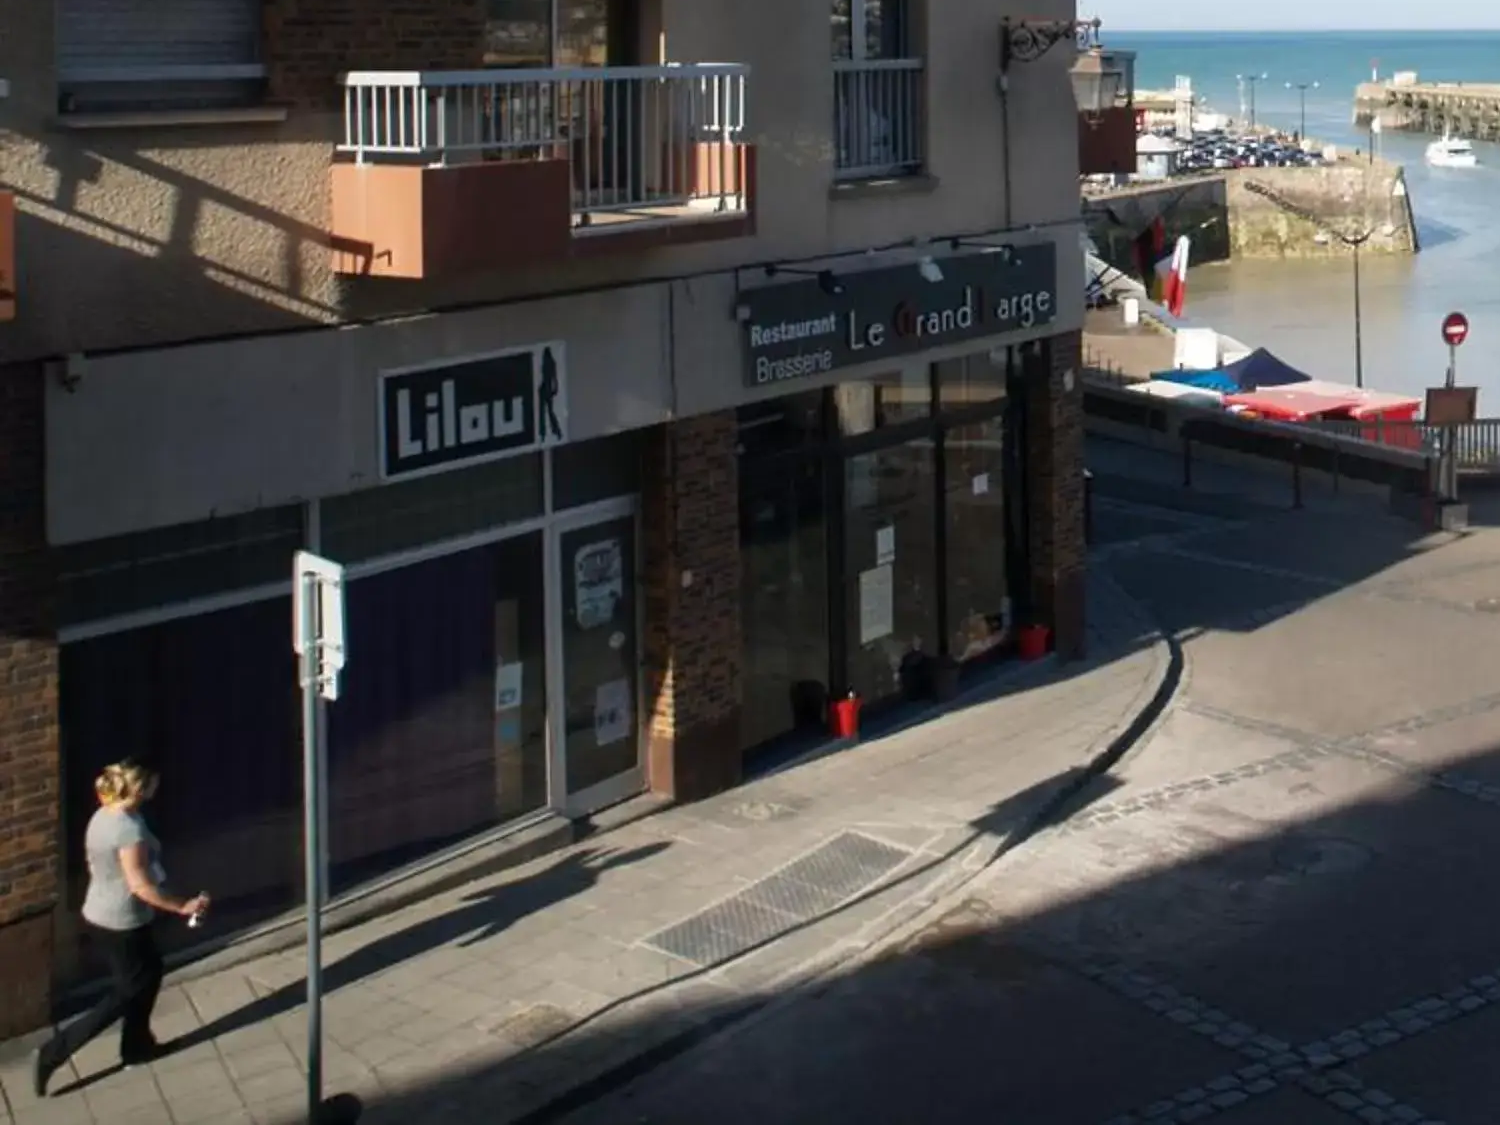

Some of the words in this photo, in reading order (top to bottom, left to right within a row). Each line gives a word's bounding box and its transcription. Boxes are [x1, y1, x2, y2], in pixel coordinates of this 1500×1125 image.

[750, 312, 837, 347] Restaurant
[849, 309, 885, 351] Le
[756, 348, 833, 383] Brasserie
[396, 378, 525, 459] Lilou
